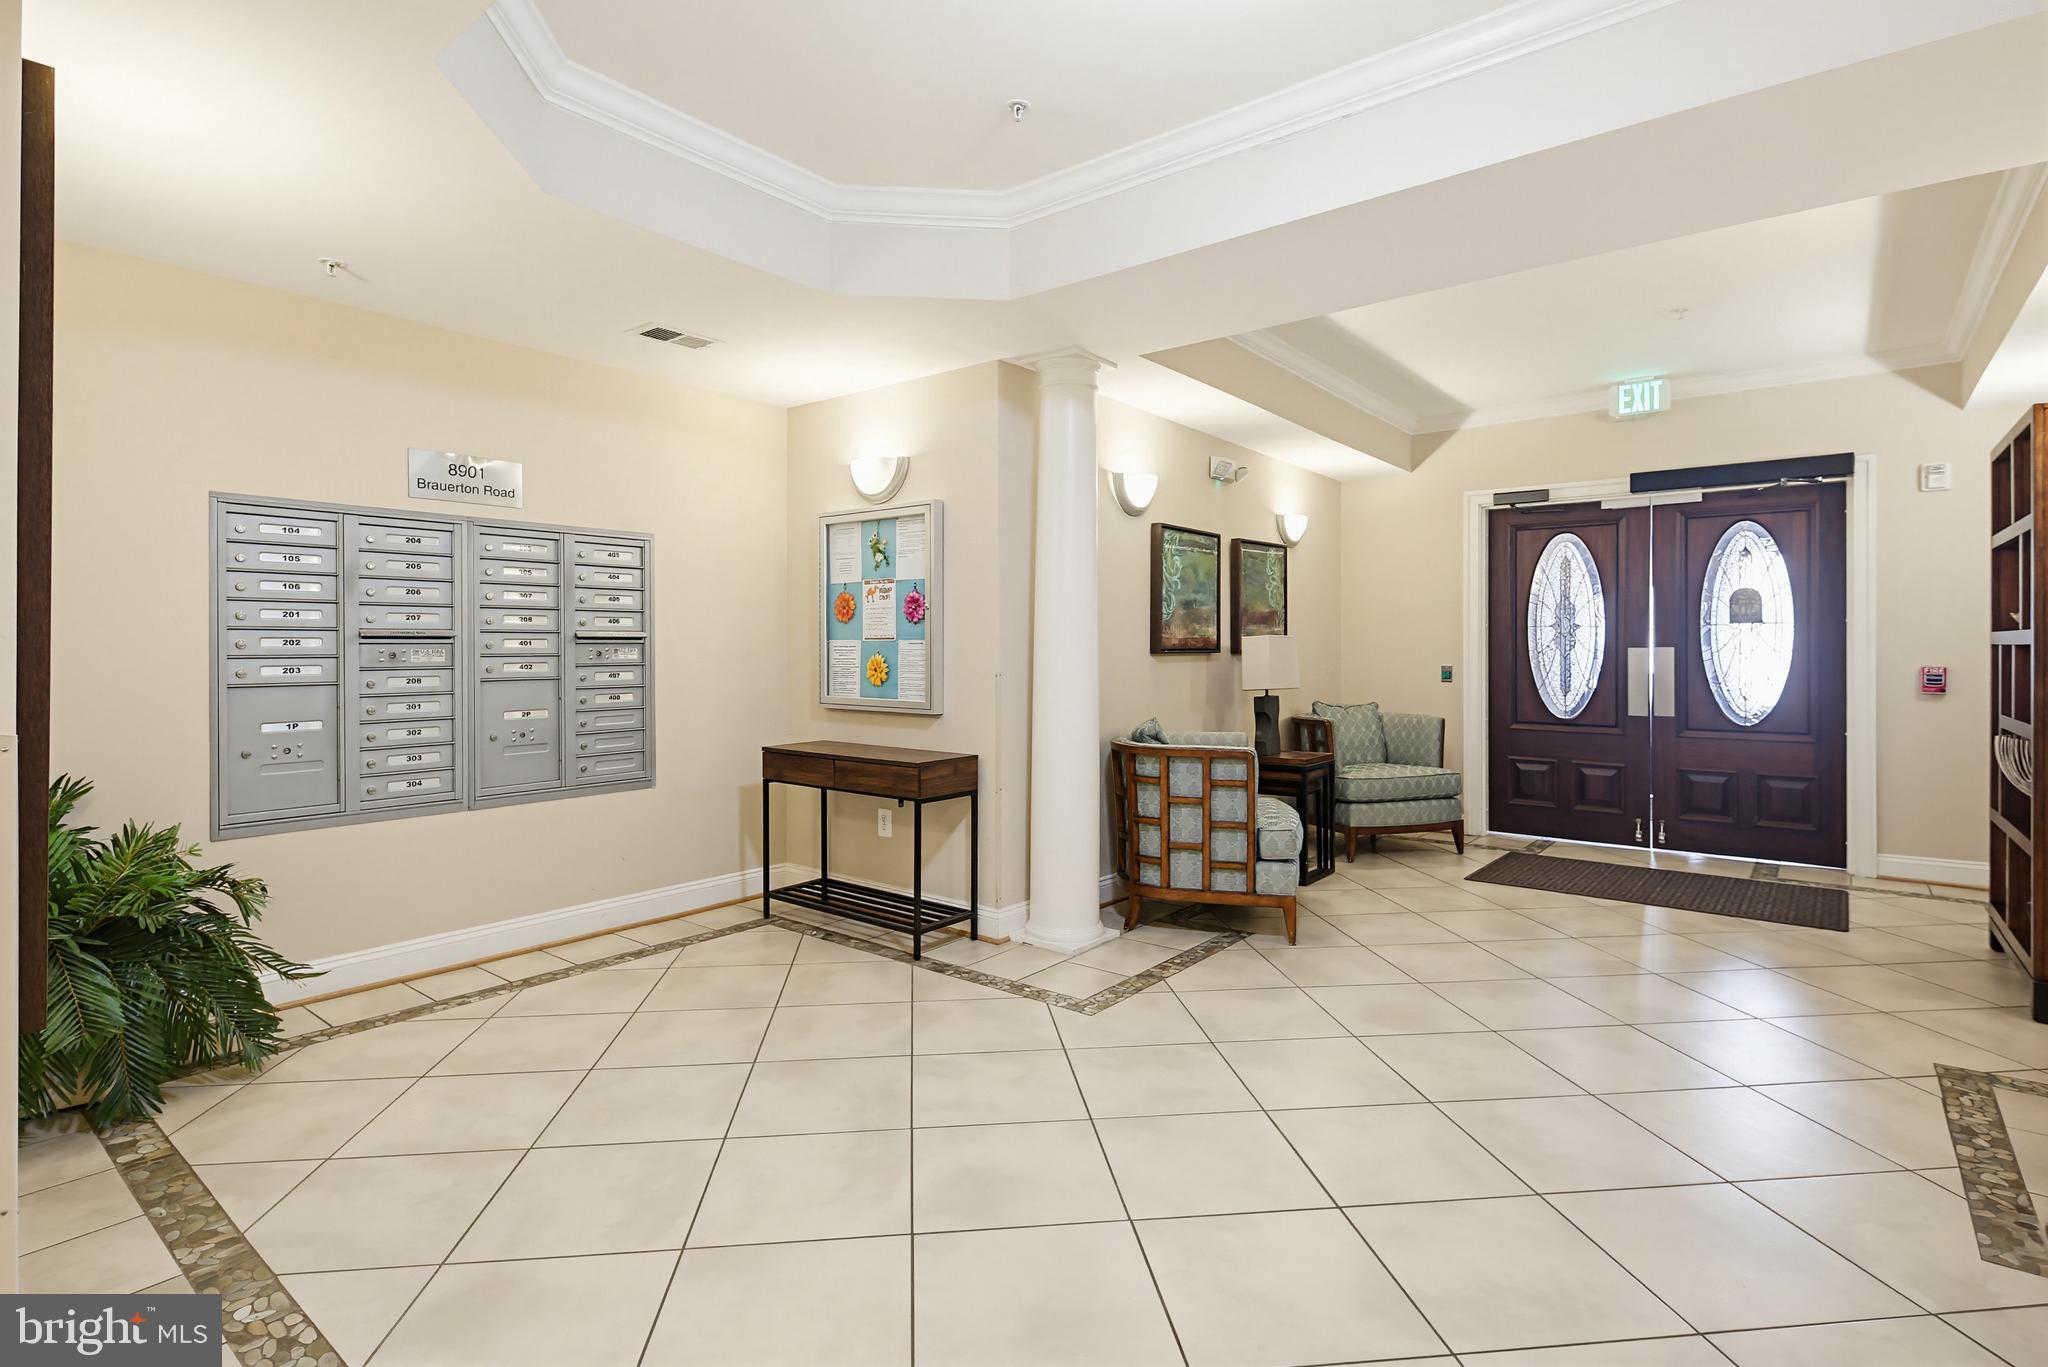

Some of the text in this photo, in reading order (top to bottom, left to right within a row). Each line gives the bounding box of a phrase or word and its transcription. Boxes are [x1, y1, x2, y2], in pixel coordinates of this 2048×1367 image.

[1618, 380, 1664, 414] EXIT
[448, 463, 484, 479] 8901
[417, 477, 515, 498] Brauerton Road
[281, 526, 301, 535] 104
[405, 536, 422, 544] 204
[281, 554, 301, 563] 105
[405, 562, 422, 570] 205
[281, 582, 301, 591] 106
[405, 588, 422, 596] 206
[281, 610, 301, 619] 201
[405, 614, 422, 622] 207
[281, 638, 301, 647] 202
[281, 666, 301, 675] 203
[406, 678, 423, 686] 208
[406, 703, 423, 711] 301
[286, 722, 299, 731] 1P
[406, 729, 423, 737] 302
[406, 754, 423, 762] 303
[406, 780, 423, 788] 304
